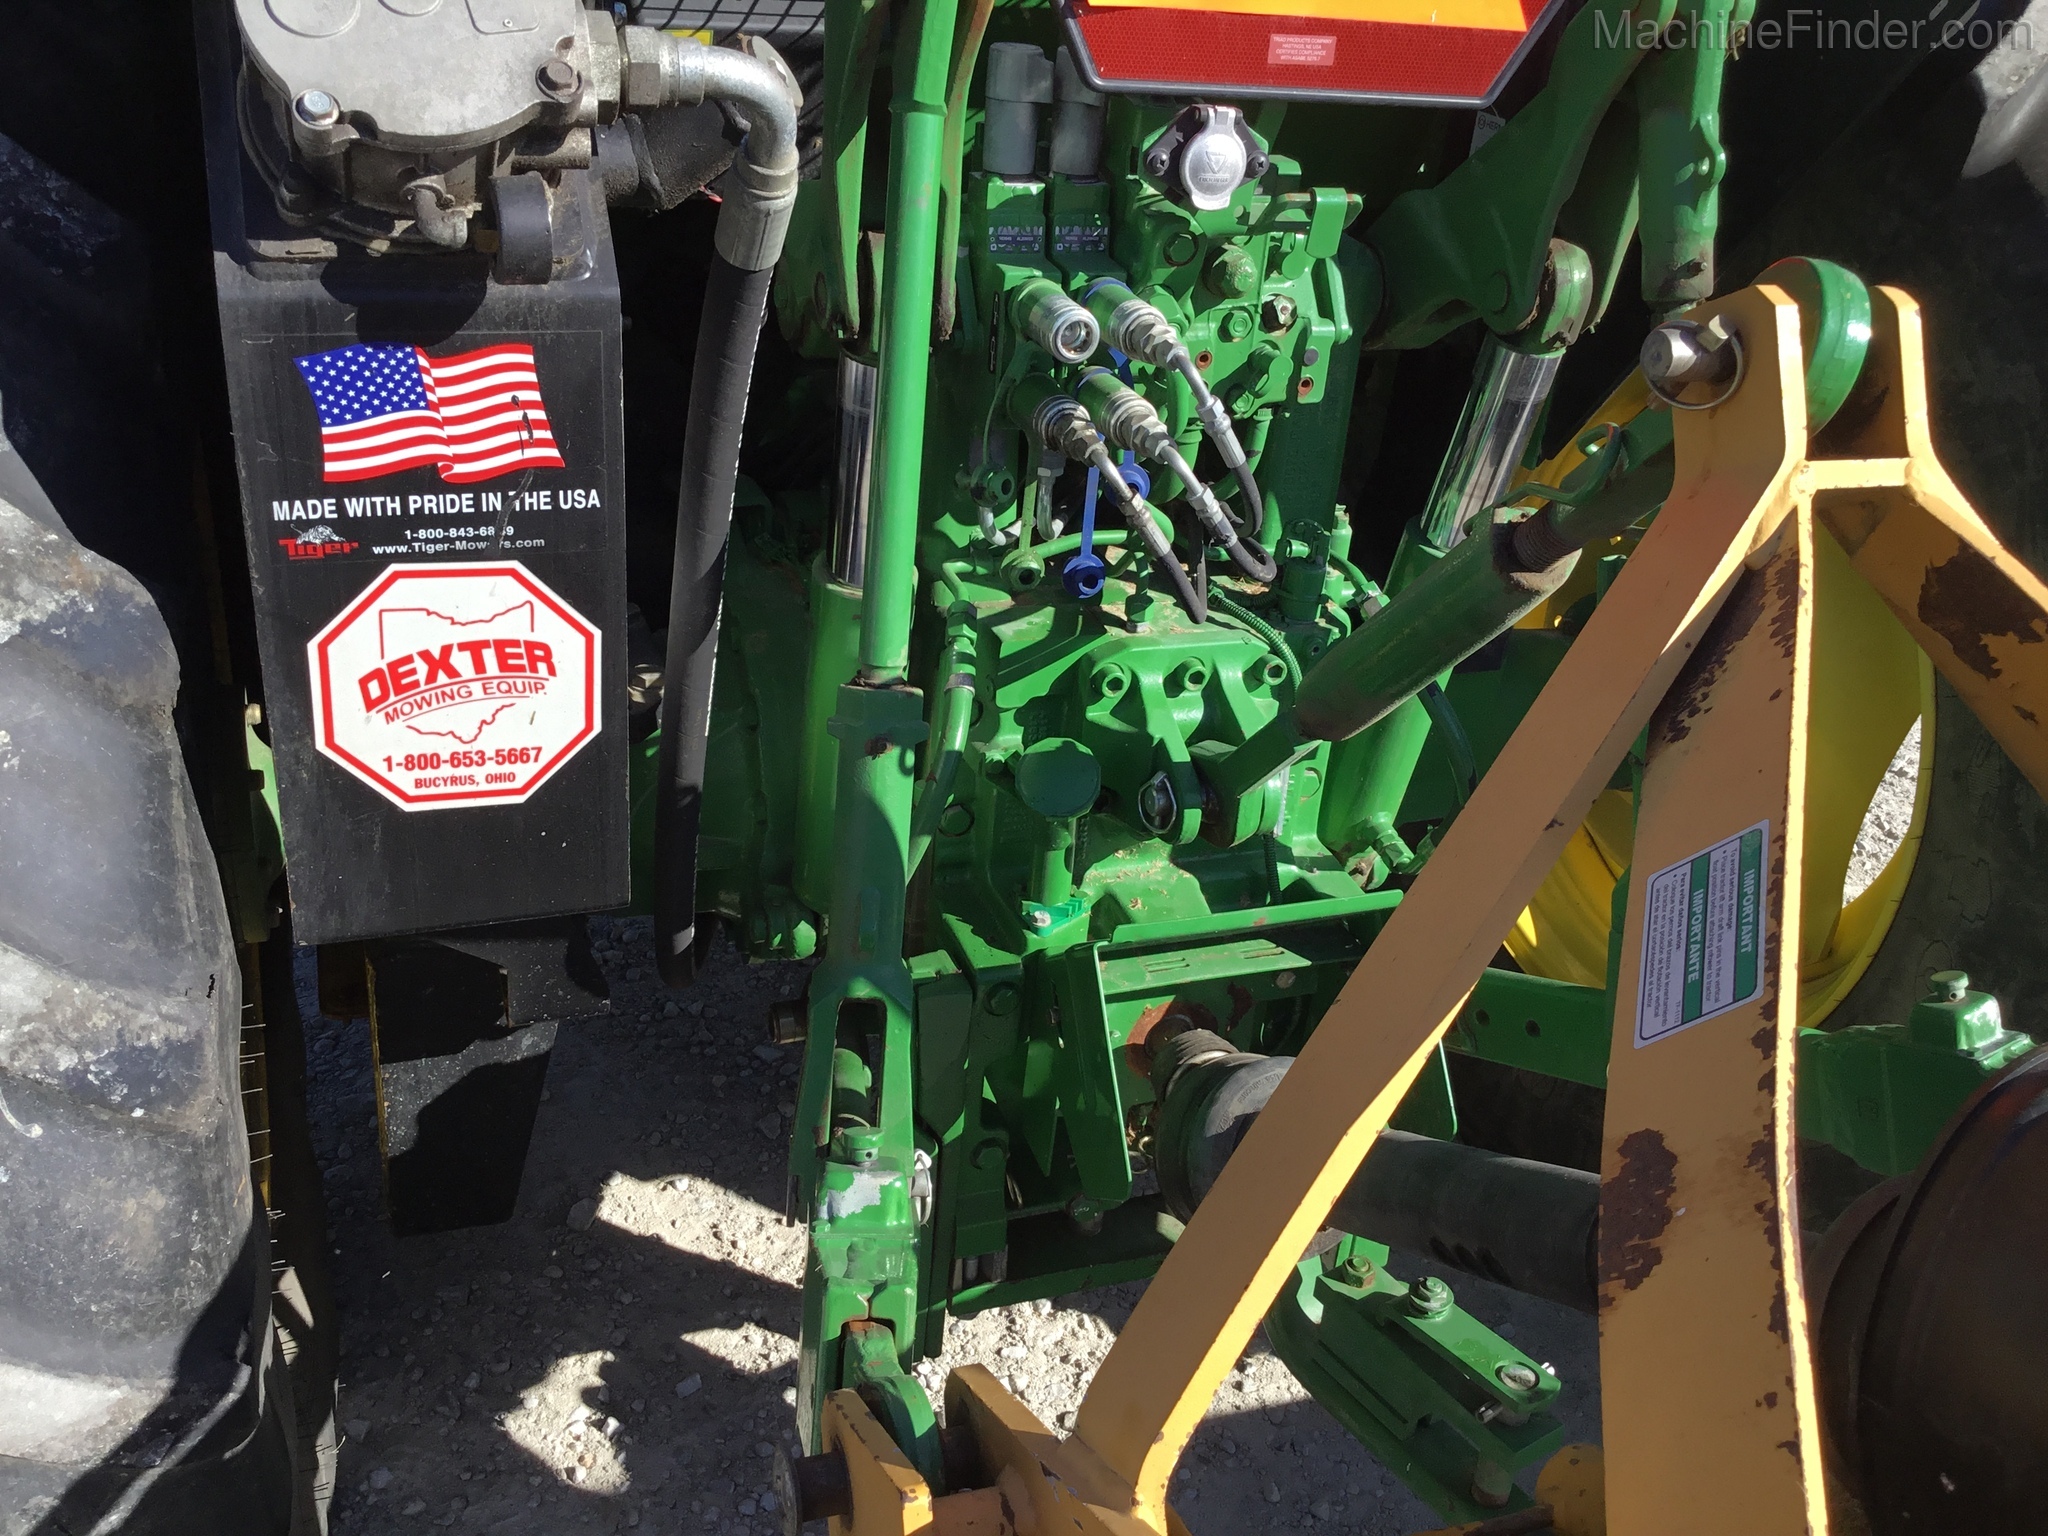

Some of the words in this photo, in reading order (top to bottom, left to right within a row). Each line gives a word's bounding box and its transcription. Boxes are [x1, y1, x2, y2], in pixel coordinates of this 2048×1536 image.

[272, 498, 338, 521] MADE
[344, 496, 401, 518] WITH
[408, 493, 475, 515] PRIDE
[481, 492, 502, 512] IN
[508, 490, 552, 512] THE
[558, 488, 601, 510] USA
[404, 525, 515, 540] 1-800-843-689
[278, 538, 359, 561] Tiger
[372, 538, 545, 555] www.Tiger-Mowrs.com
[358, 639, 557, 713] DEXTER
[384, 684, 473, 725] MOWING
[481, 680, 547, 696] EQUIP.
[382, 746, 543, 772] 1-800-653-5667
[414, 774, 480, 789] BUCYRUS,
[485, 772, 516, 784] OHIO
[1730, 849, 1737, 857] To
[1678, 887, 1686, 906] evitar
[1725, 902, 1734, 932] damage:
[1740, 868, 1754, 954] IMPORTANT
[1687, 888, 1703, 983] IMPORTANTE
[1706, 919, 1715, 948] attaching
[1713, 978, 1721, 1003] vertical
[1653, 994, 1661, 1017] vertical
